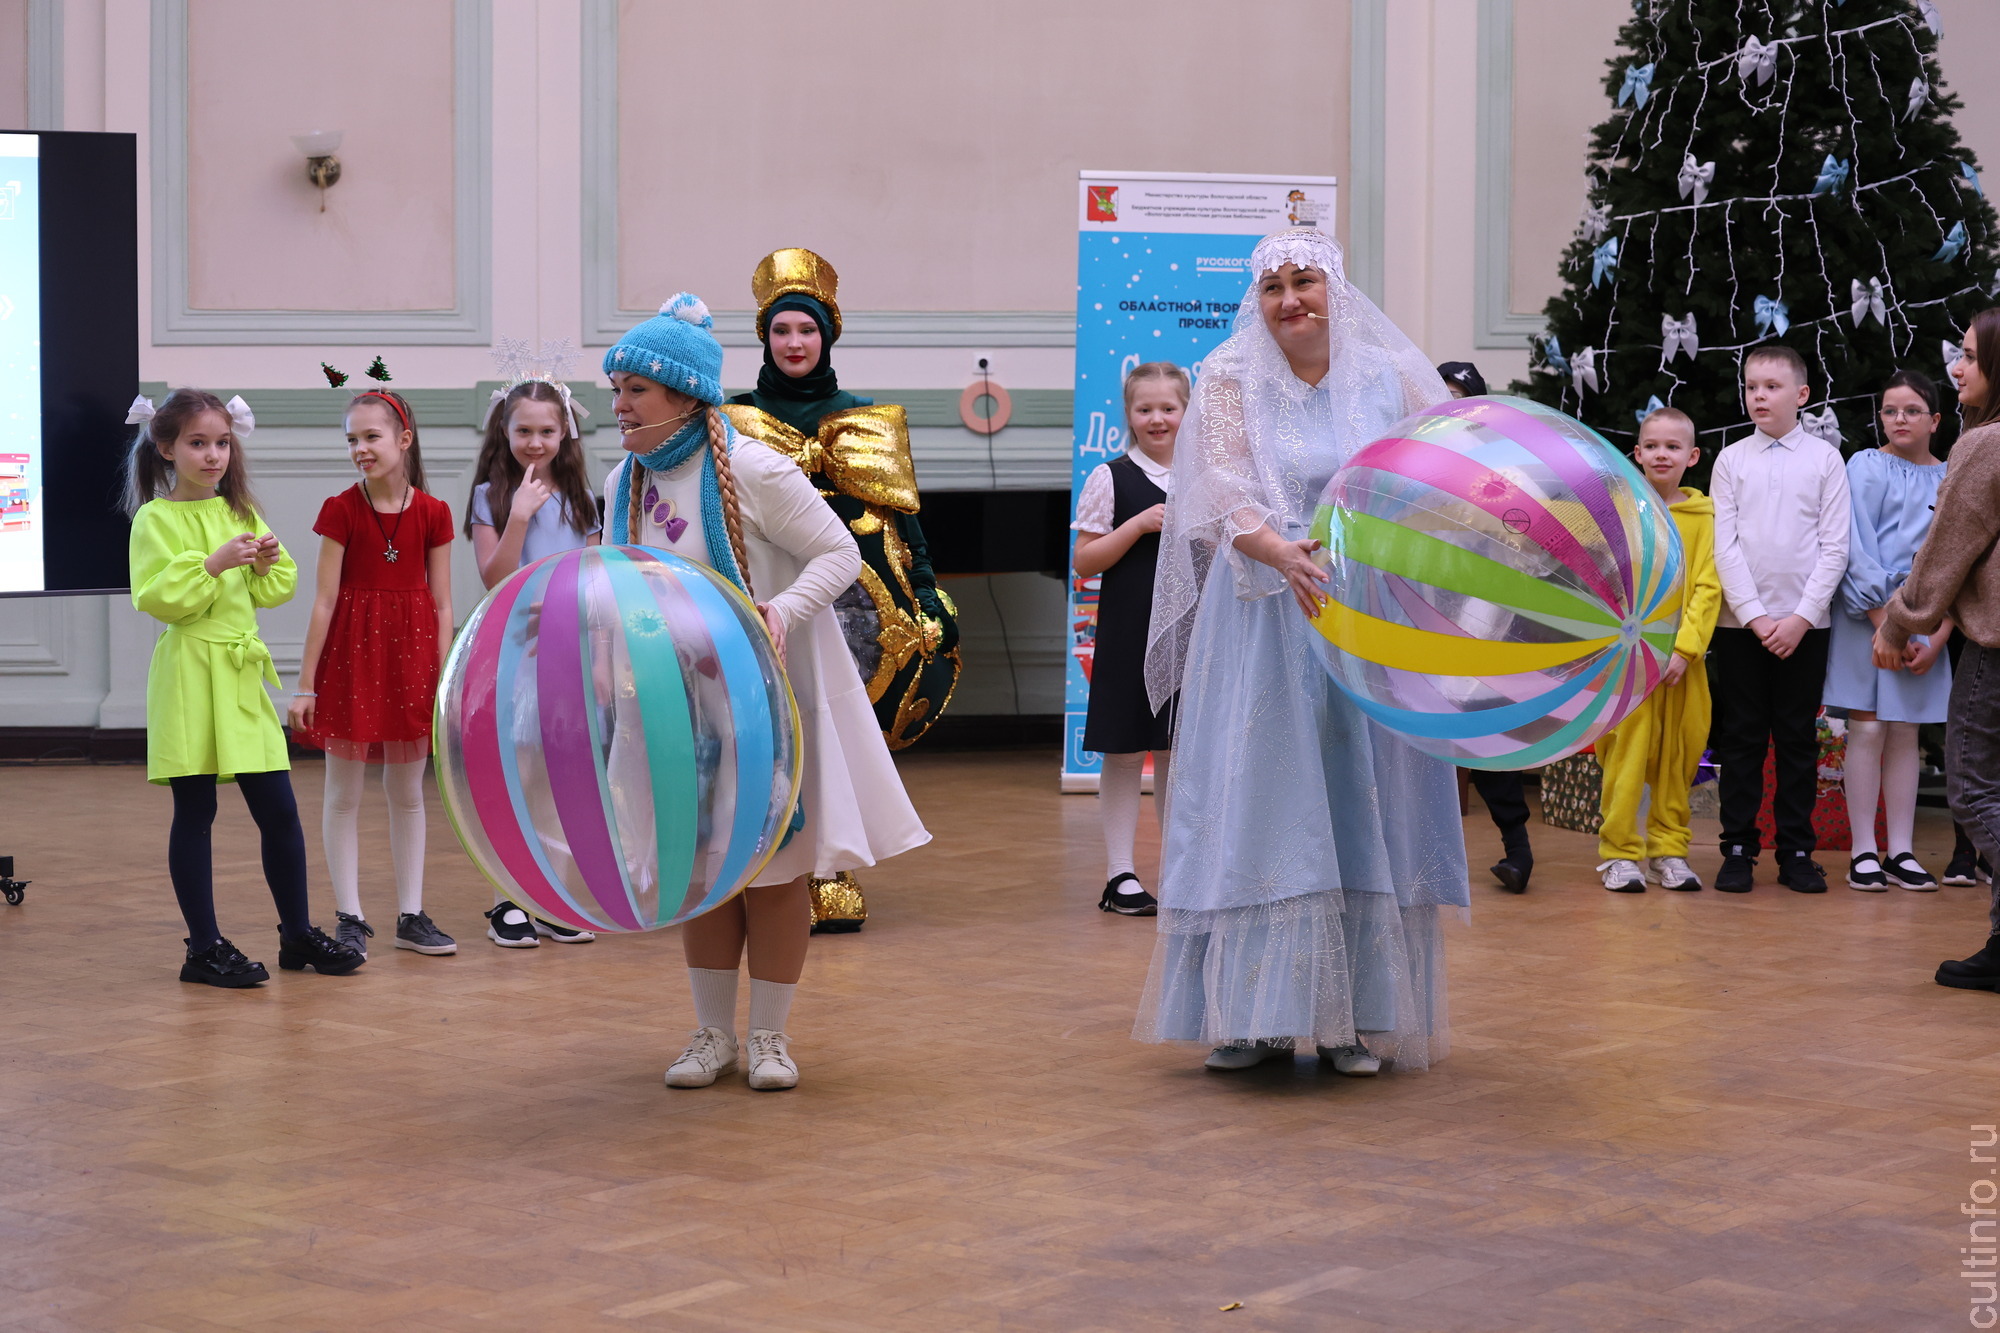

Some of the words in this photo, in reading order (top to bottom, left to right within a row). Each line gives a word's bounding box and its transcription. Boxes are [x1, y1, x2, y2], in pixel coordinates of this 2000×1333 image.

[1196, 257, 1252, 267] РУССКОГО
[1119, 300, 1202, 312] ОБЛАСТНОЙ
[1206, 303, 1241, 314] ТВОР
[1179, 318, 1228, 329] ПРОЕКТ
